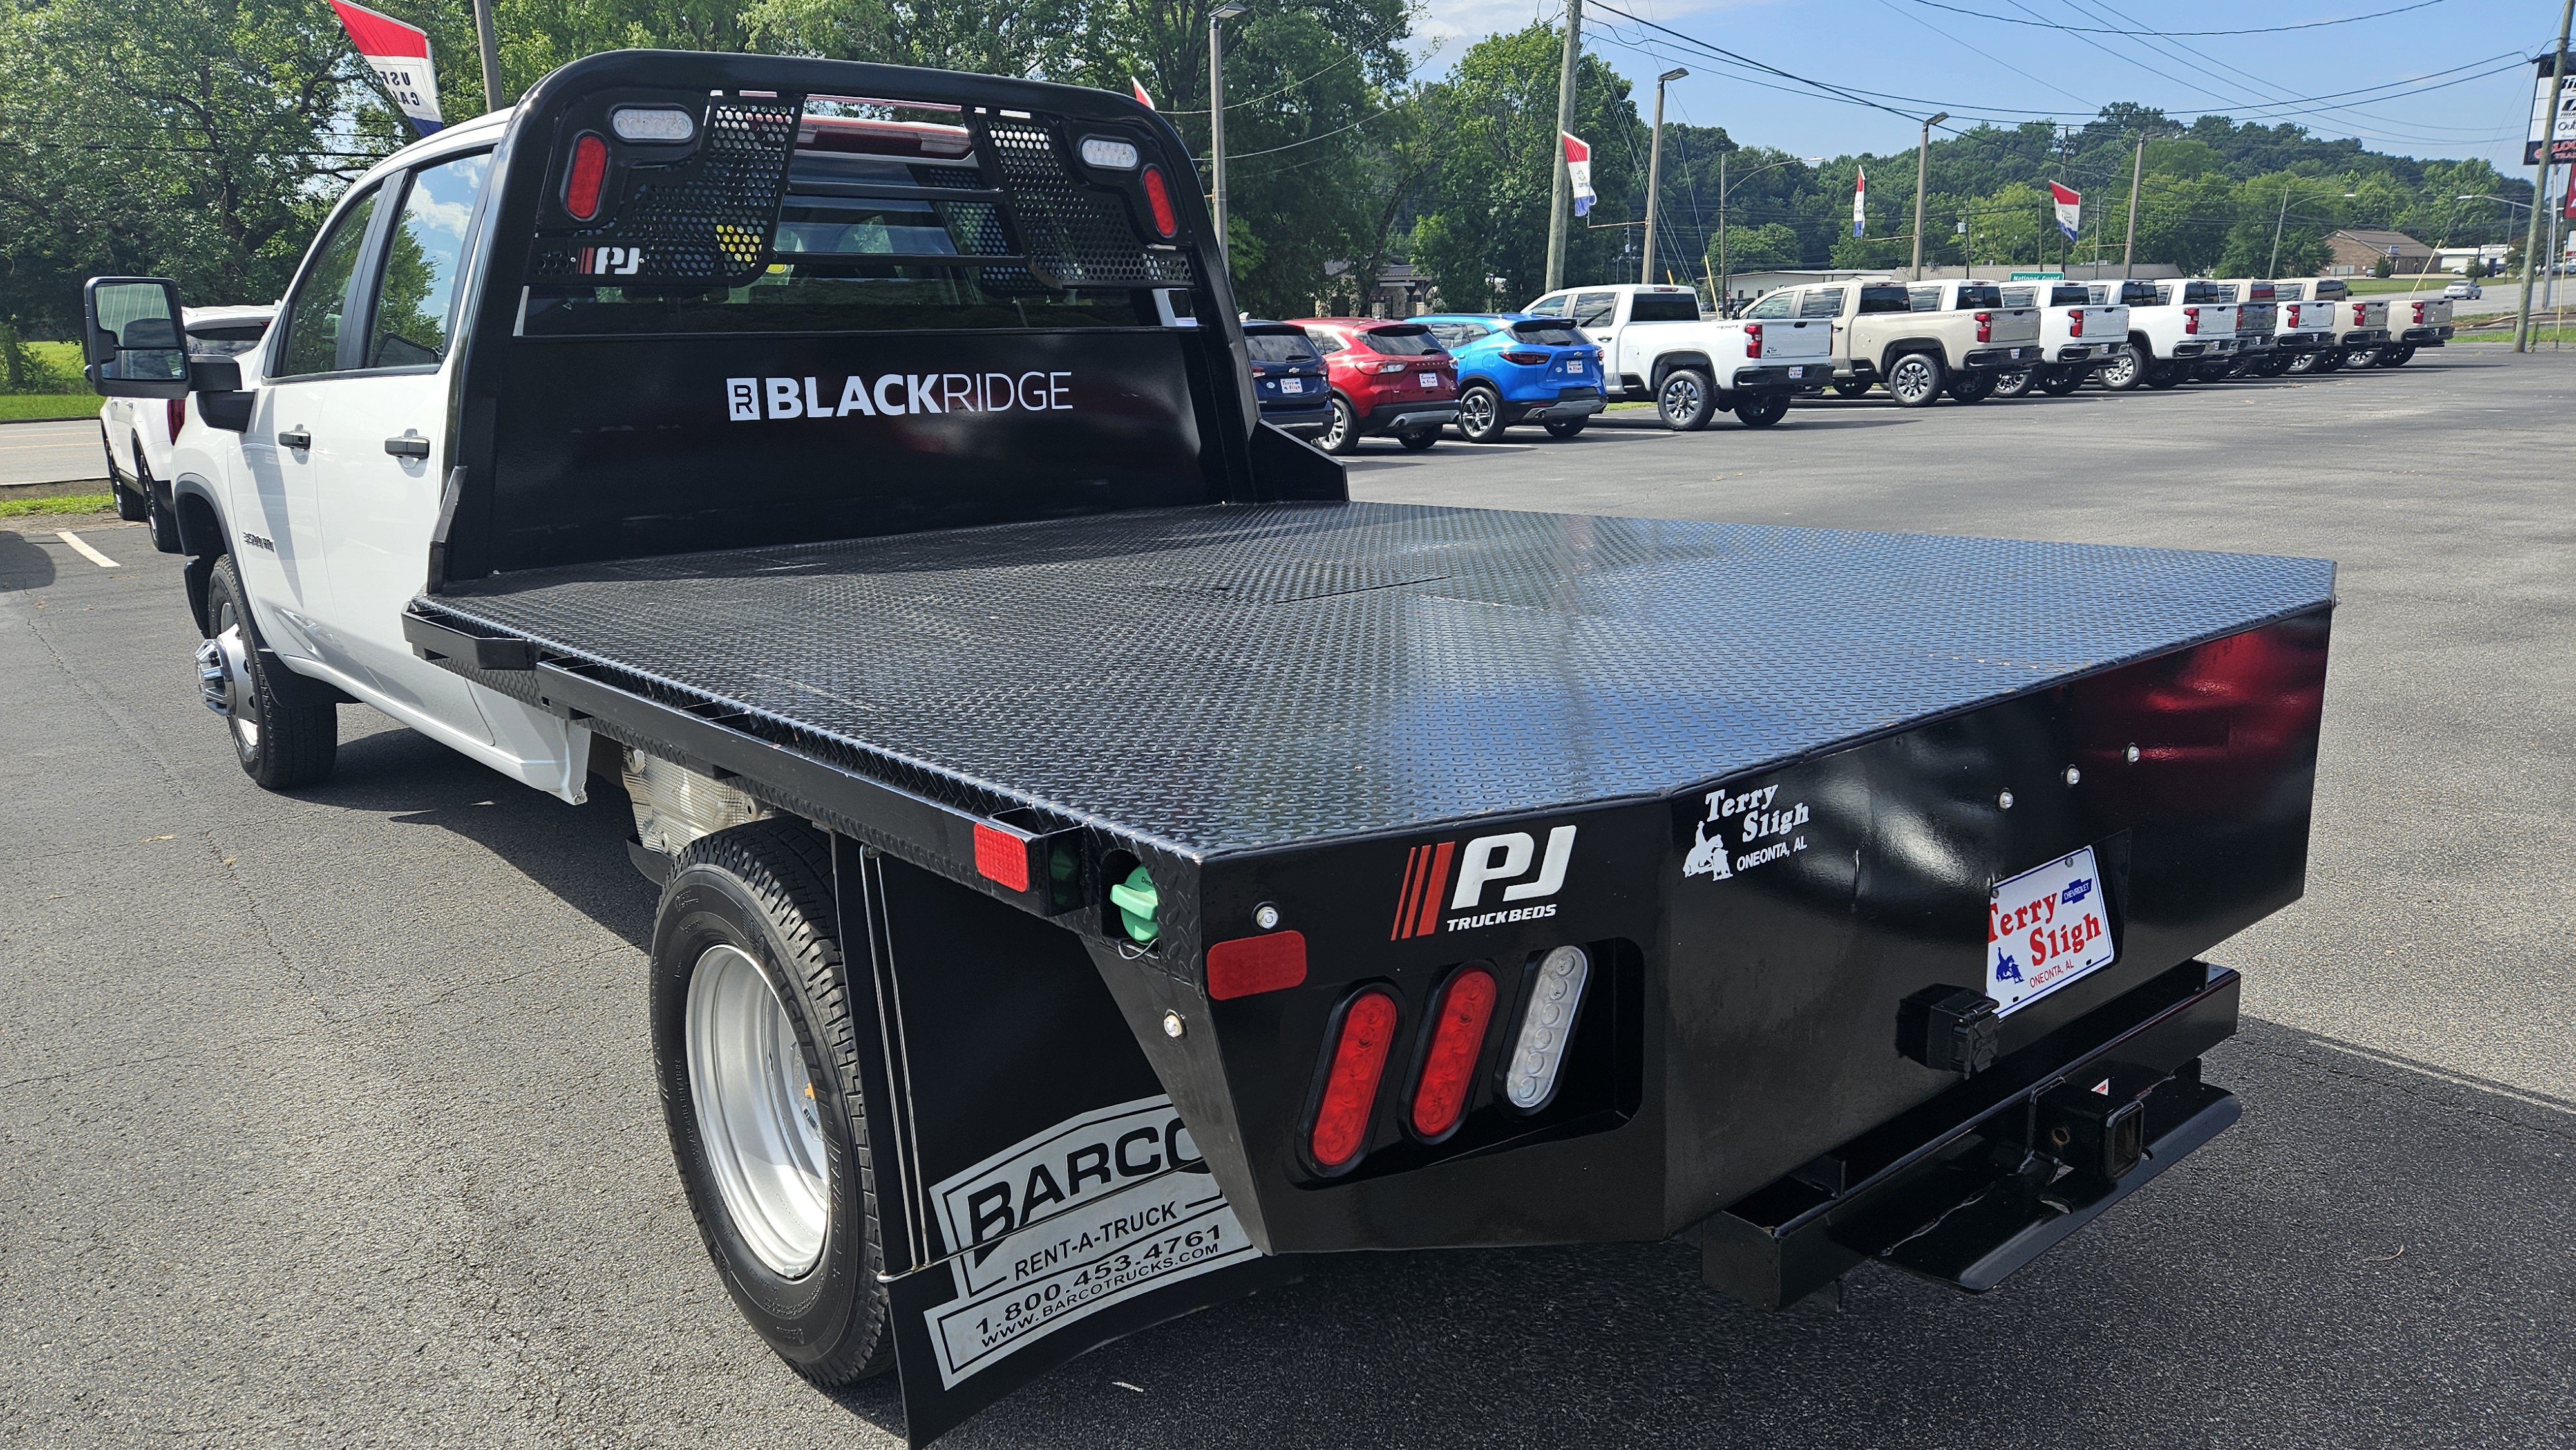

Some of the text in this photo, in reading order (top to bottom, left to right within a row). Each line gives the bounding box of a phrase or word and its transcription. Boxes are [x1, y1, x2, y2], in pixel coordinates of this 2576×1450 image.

[594, 247, 640, 274] PJ
[765, 372, 1074, 419] BLACKRIDGE
[1705, 784, 1779, 822] Terry
[1742, 802, 1810, 842] Sligh
[1450, 825, 1577, 910] PJ
[1736, 836, 1808, 871] ONEONTA, AL
[2063, 883, 2090, 900] CHEVROLET
[2029, 913, 2102, 966] Sligh
[2030, 959, 2074, 988] ONEONTA, AL
[1014, 1201, 1178, 1281] RENT-A-TRUCK
[976, 1224, 1220, 1335] 1.800.453.4761
